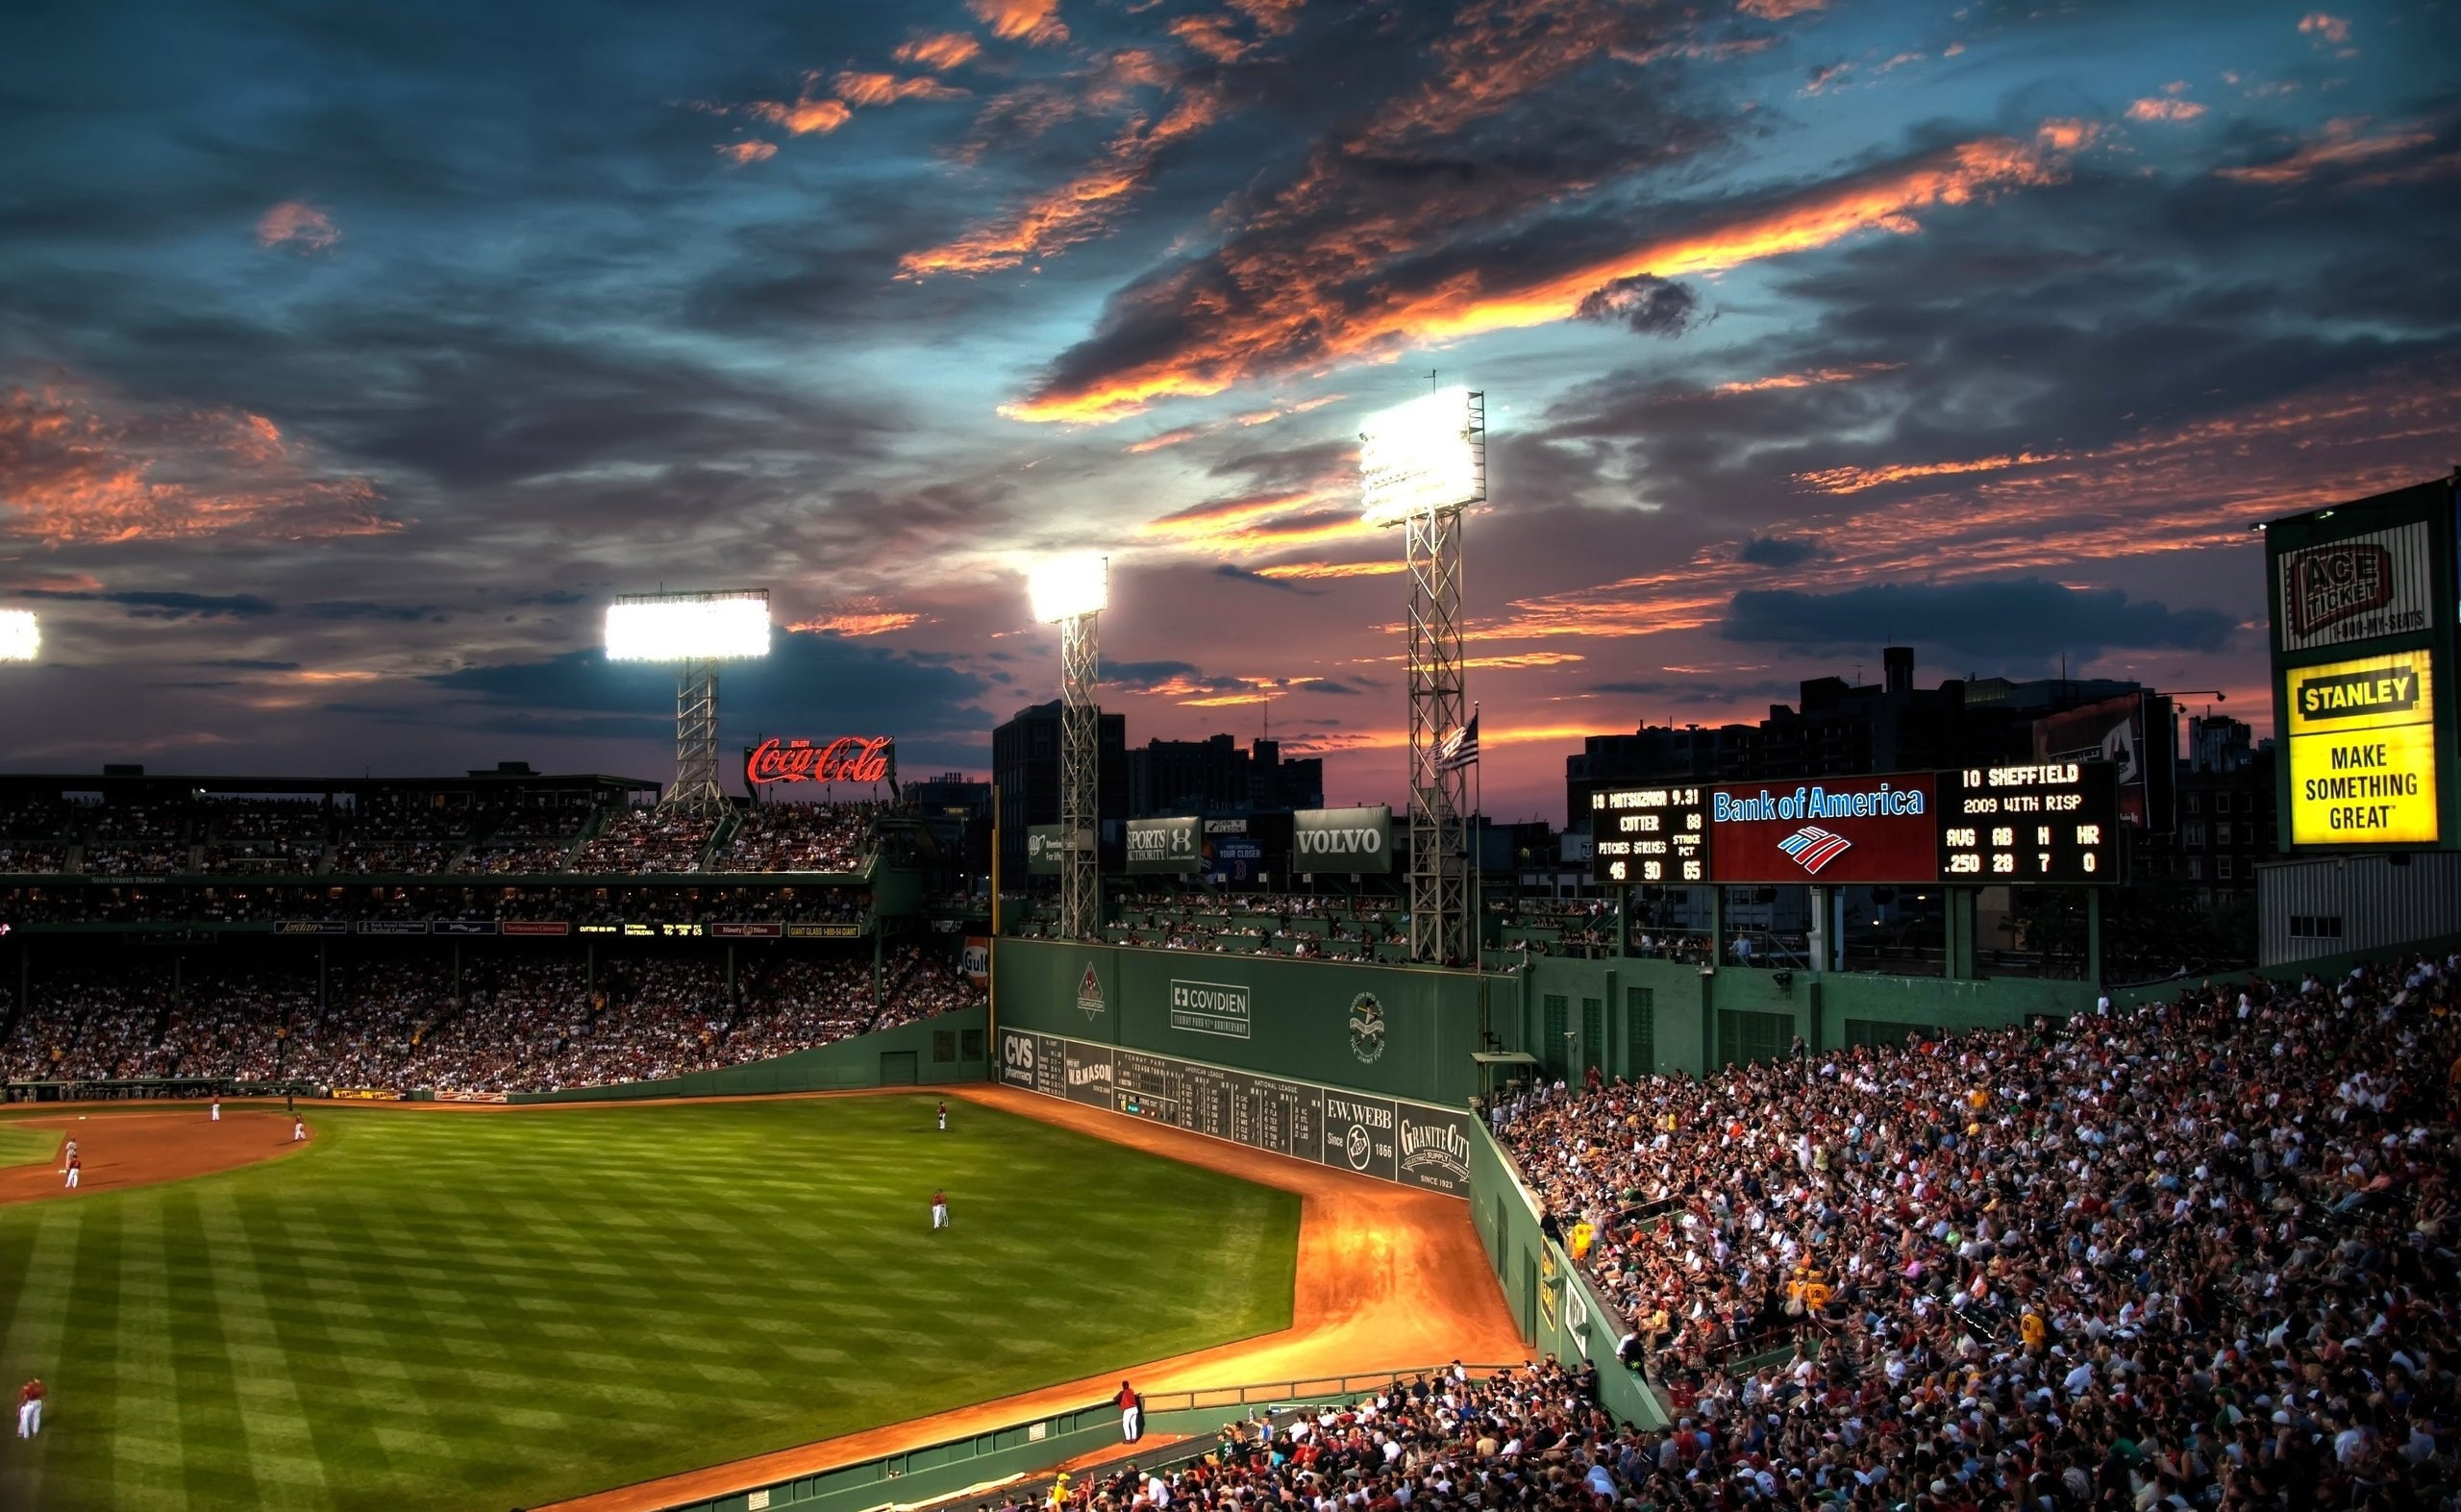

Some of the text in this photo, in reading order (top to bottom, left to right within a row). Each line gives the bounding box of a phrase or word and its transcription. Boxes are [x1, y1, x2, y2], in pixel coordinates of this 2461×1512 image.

[2306, 551, 2379, 597] ACE
[2306, 584, 2378, 621] TICKET
[2305, 677, 2410, 711] STANLEY
[748, 736, 894, 783] Coca-Cola
[2330, 744, 2387, 770] MAKE
[1988, 763, 2079, 786] SHEFFIELD
[2305, 773, 2418, 801] SOMETHING
[1714, 782, 1925, 822] Bank of America
[1963, 793, 2082, 814] 2009 WITH RISP
[1620, 815, 1659, 831] CUTTER
[2329, 806, 2391, 830] GREAT
[1127, 830, 1166, 851] SPORTS
[1296, 828, 1381, 855] VOLVO
[1673, 833, 1701, 845] STRIKE
[1946, 824, 2100, 847] AVG AB H HR
[1598, 840, 1696, 856] PITCHES STRIKES PCT
[1609, 860, 1701, 880] 46 30 65
[1944, 852, 2095, 873] .250 28 7 0
[722, 926, 743, 934] Ninety
[790, 926, 805, 936] GIANT
[805, 926, 822, 936] GLASS
[1190, 989, 1246, 1014] COVIDIEN
[1005, 1034, 1033, 1069] CVS
[1125, 1053, 1165, 1067] FENWAY PARK
[1005, 1065, 1033, 1086] pharmacy
[1184, 1066, 1225, 1079] AMERICAN LEAGUE
[1254, 1078, 1298, 1095] NATIONAL LEAGUE
[1351, 1103, 1392, 1130] WEBB
[1327, 1131, 1344, 1148] Since
[1375, 1142, 1392, 1159] 1866
[1401, 1119, 1446, 1156] GRANITE
[1426, 1151, 1450, 1163] SUPPLY
[1420, 1174, 1454, 1190] SINCE 1923
